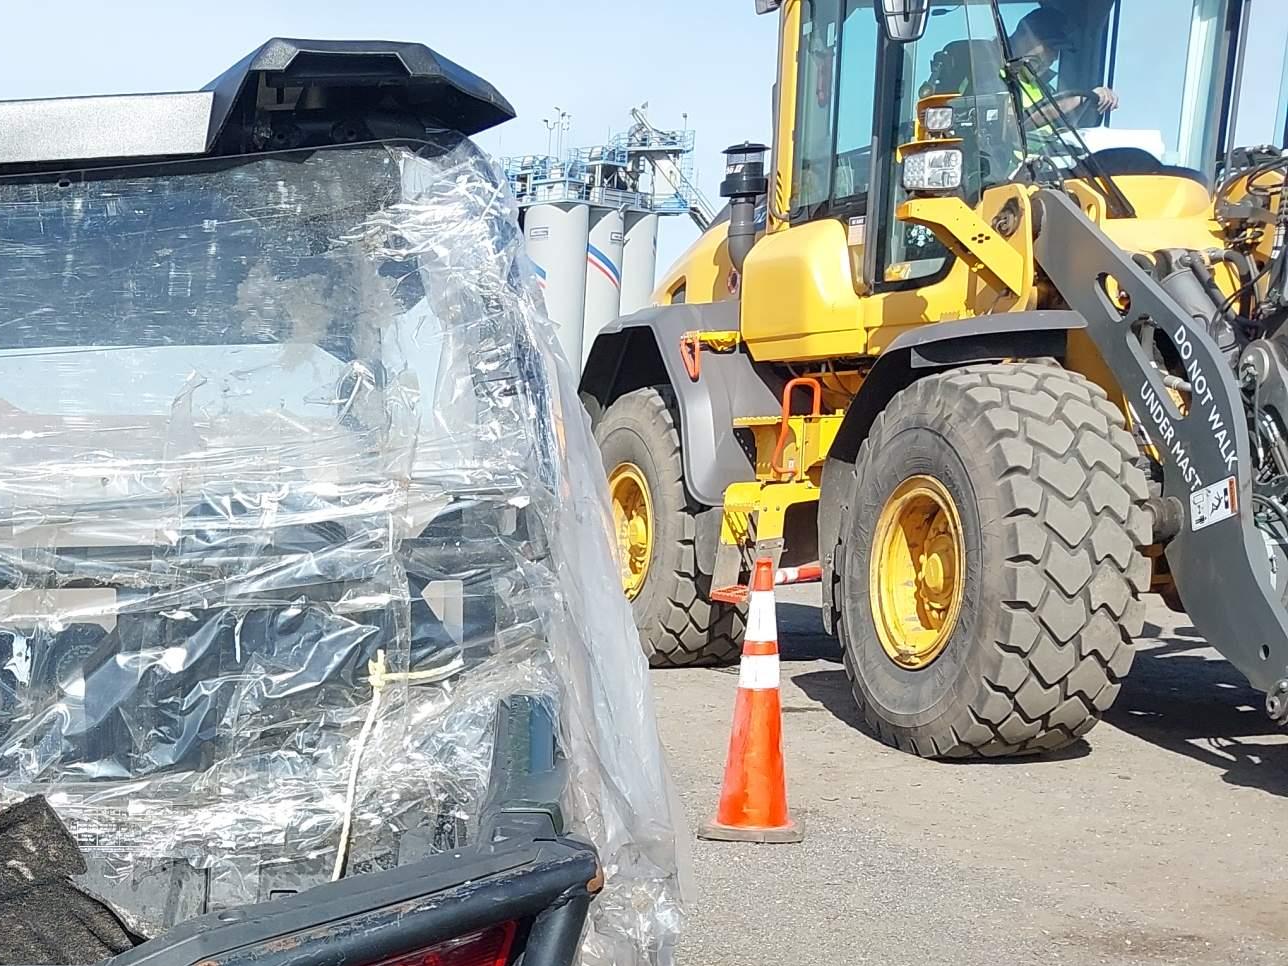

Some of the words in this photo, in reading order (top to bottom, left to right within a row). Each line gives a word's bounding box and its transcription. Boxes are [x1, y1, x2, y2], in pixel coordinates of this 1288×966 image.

[1140, 380, 1175, 447] UNDER
[1171, 441, 1202, 492] MAST
[1174, 325, 1193, 360] DO
[1187, 359, 1214, 406] NOT
[1208, 404, 1239, 472] WALK
